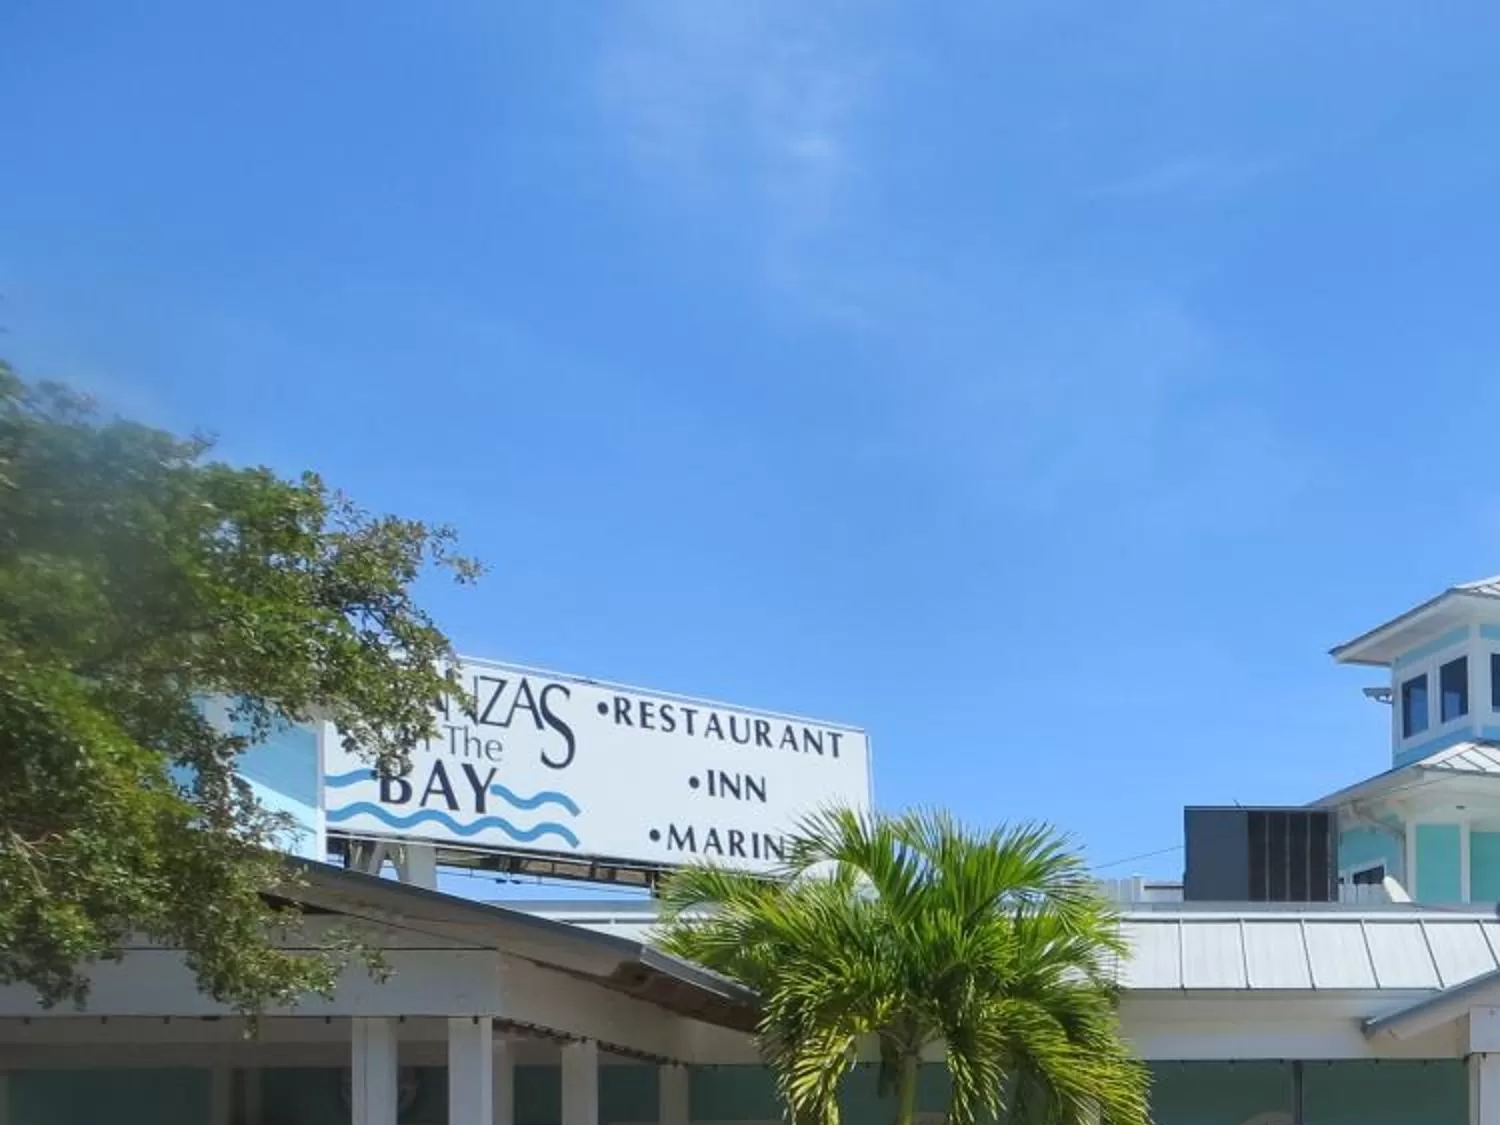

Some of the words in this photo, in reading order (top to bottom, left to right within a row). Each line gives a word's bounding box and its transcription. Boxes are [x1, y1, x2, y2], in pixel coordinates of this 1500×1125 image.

[443, 724, 504, 762] The
[613, 696, 844, 759] RESTAURANT
[706, 769, 767, 803] INN
[666, 823, 787, 861] MARIN
